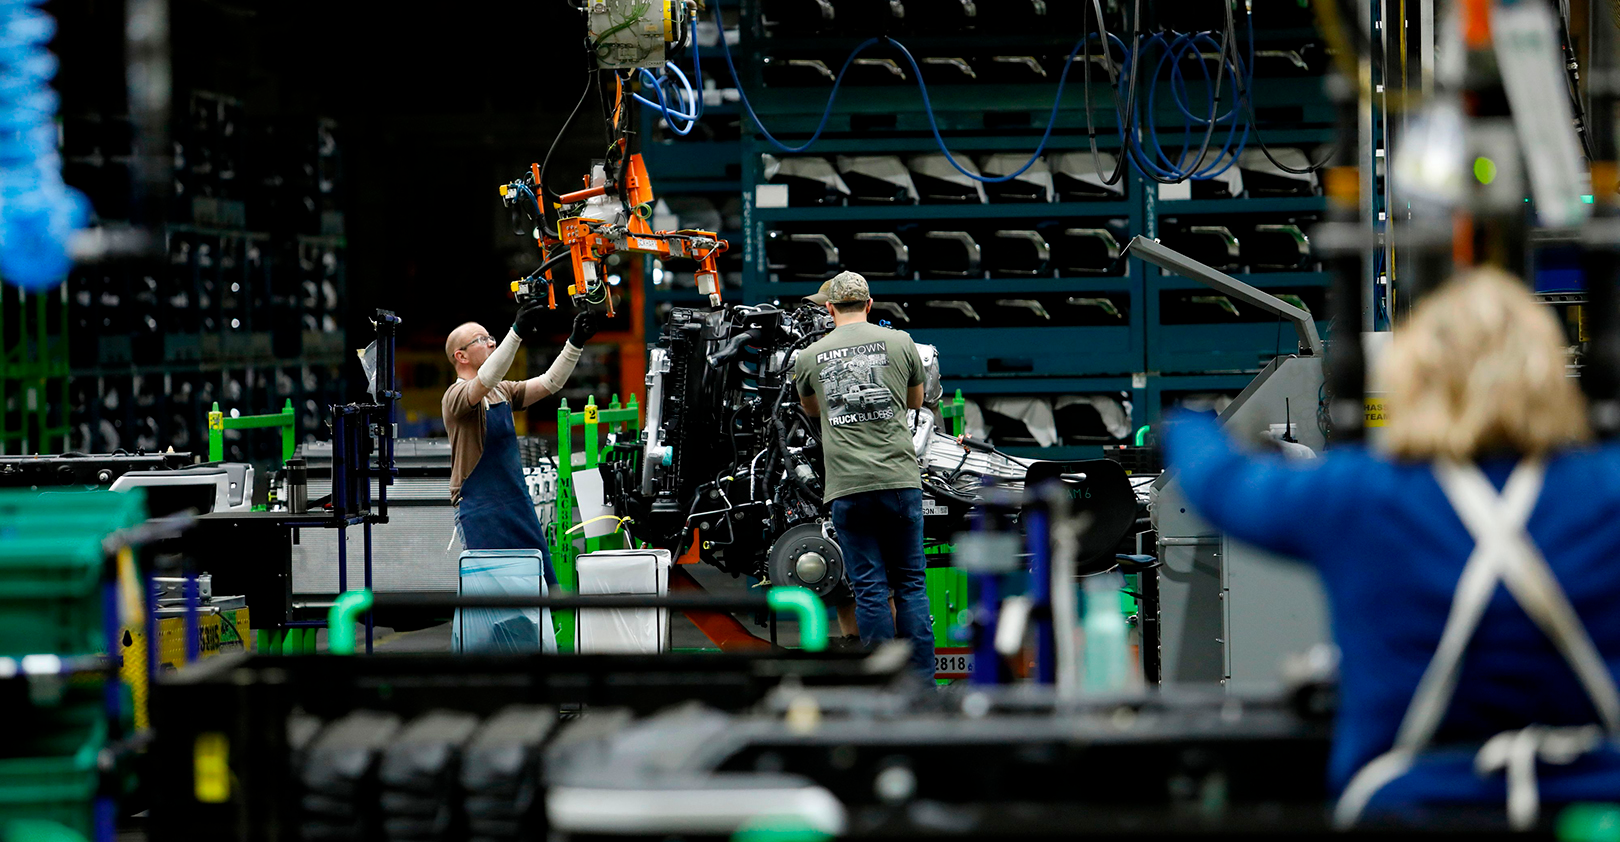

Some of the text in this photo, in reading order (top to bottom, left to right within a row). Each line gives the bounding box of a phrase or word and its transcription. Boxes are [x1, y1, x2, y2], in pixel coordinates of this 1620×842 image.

[817, 342, 886, 363] FLINT TOWN
[589, 410, 596, 419] 2
[829, 408, 894, 426] TRUCK BUILDERS
[1085, 487, 1092, 499] 6
